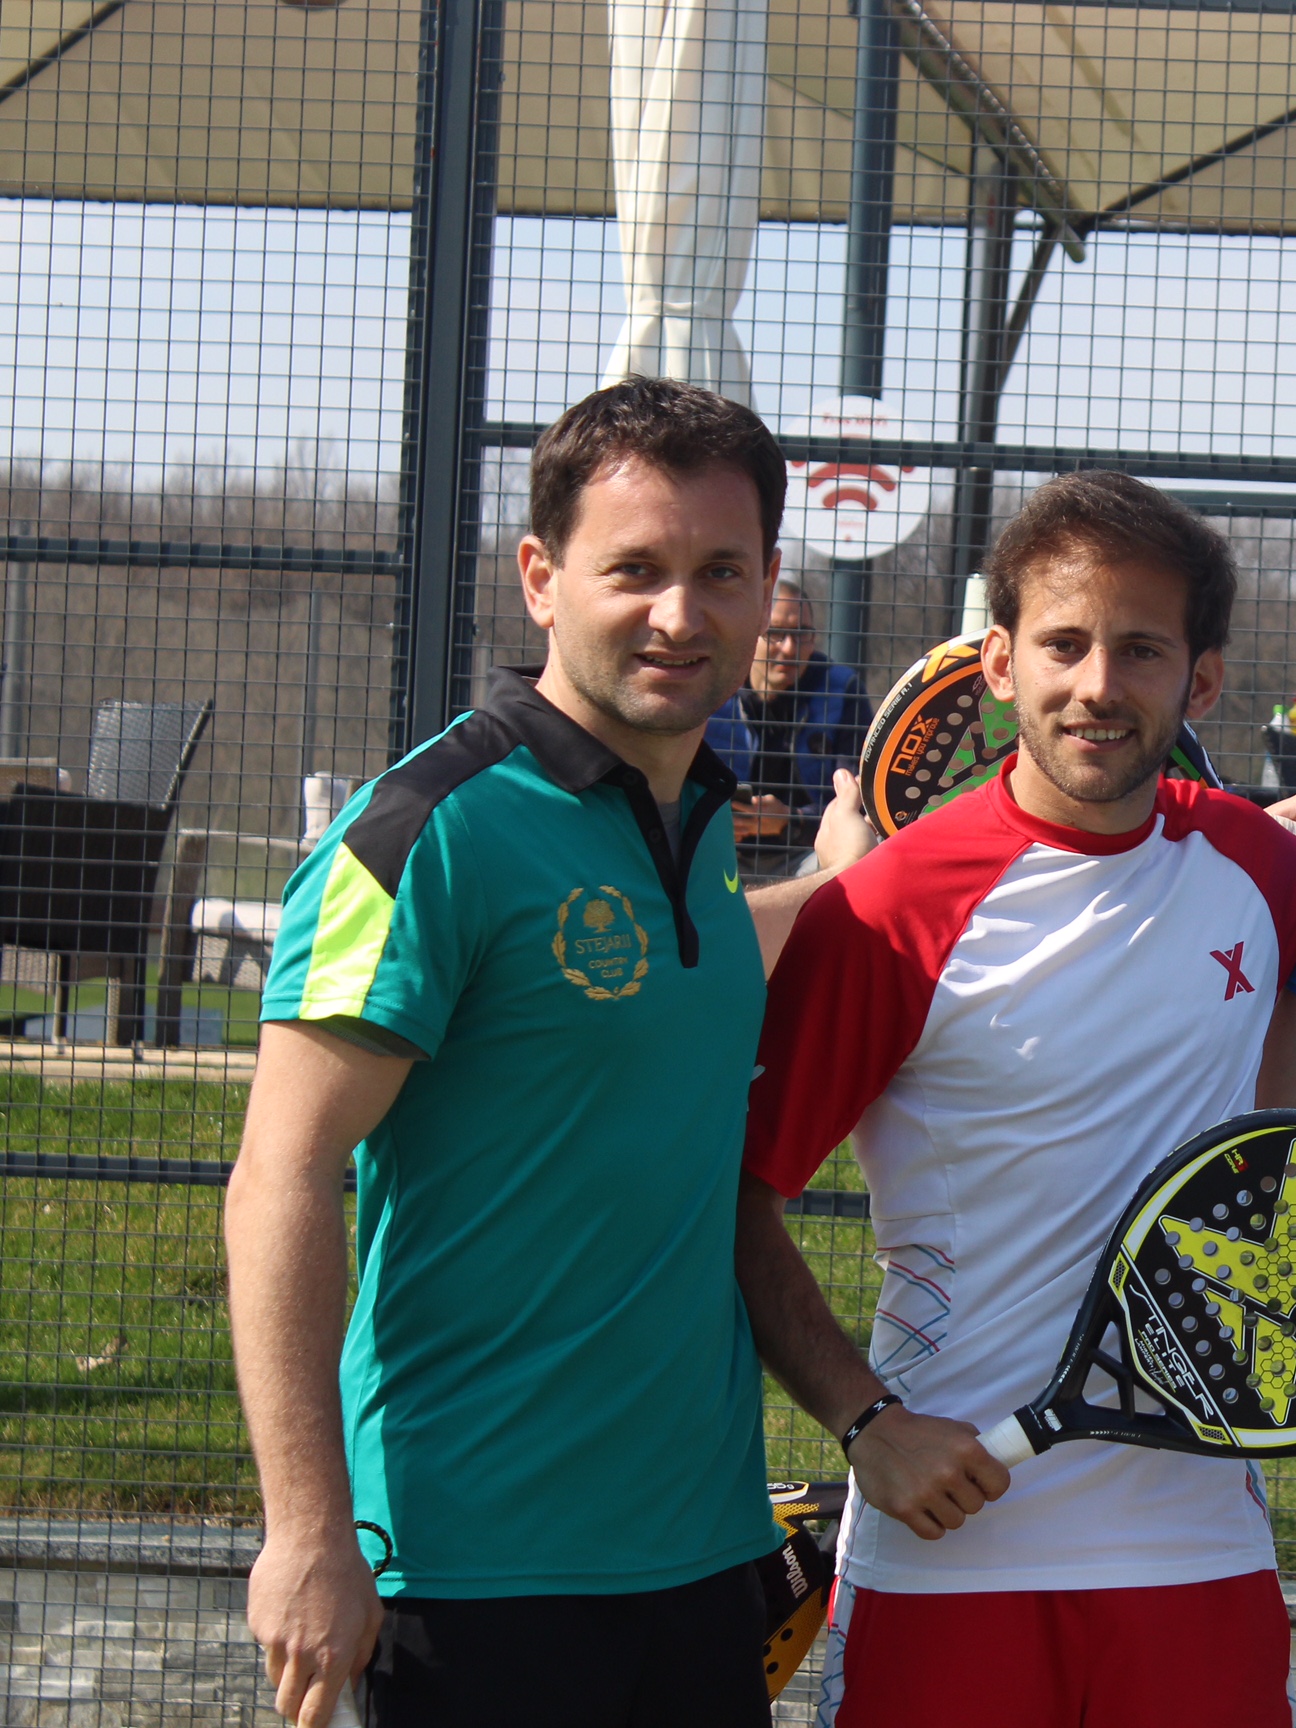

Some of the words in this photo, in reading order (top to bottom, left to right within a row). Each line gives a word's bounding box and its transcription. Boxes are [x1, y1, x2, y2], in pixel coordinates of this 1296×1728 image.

[865, 717, 886, 762] ADVANCED
[884, 693, 902, 718] SERIE
[906, 755, 920, 776] makes
[915, 742, 926, 754] you
[923, 718, 939, 743] improve
[1129, 1284, 1214, 1419] STINGER
[1141, 1331, 1155, 1352] PRO
[1154, 1353, 1176, 1388] SERIES
[1145, 1323, 1185, 1387] ELITE
[783, 1544, 808, 1598] Wilson
